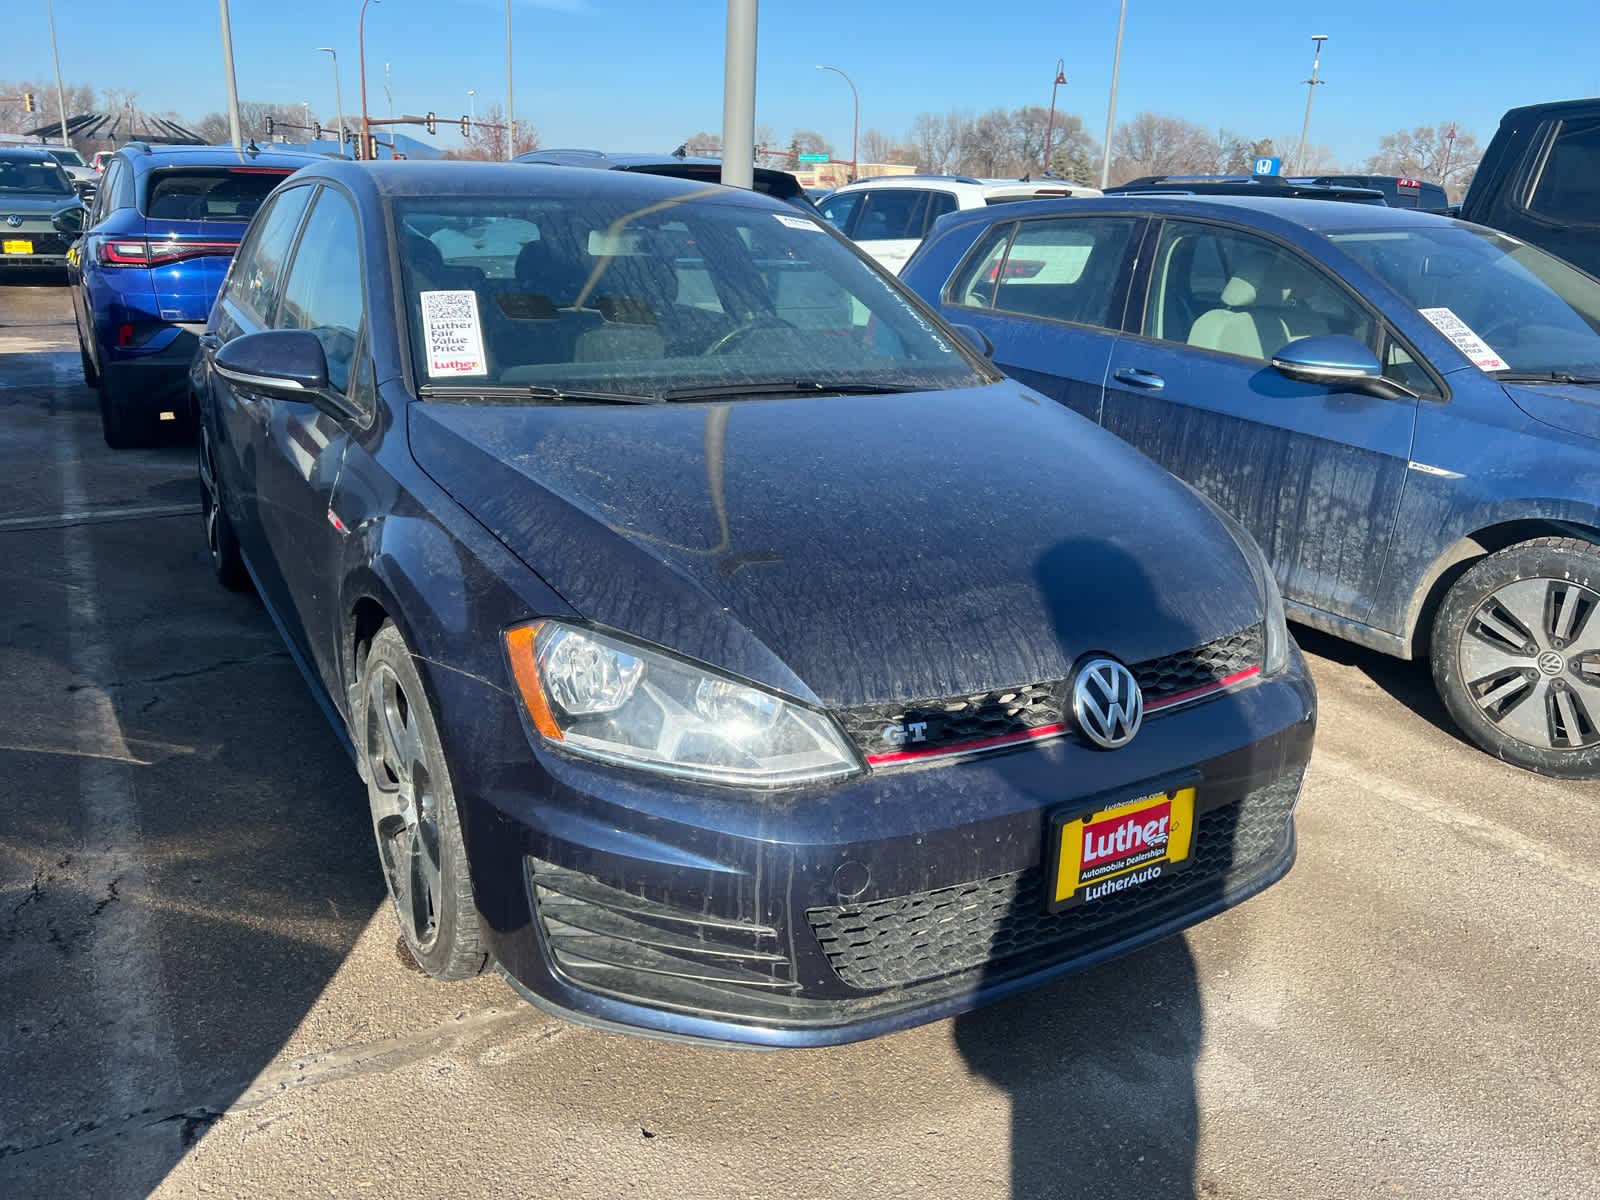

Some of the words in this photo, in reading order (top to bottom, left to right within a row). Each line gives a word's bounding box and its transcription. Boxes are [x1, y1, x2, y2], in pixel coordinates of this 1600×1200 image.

[430, 322, 472, 330] Luther
[434, 361, 479, 369] Luther
[1084, 815, 1169, 863] Luther
[1081, 860, 1125, 880] Automobile
[1126, 848, 1165, 866] Dealerships
[1085, 866, 1162, 902] LutherAuto
